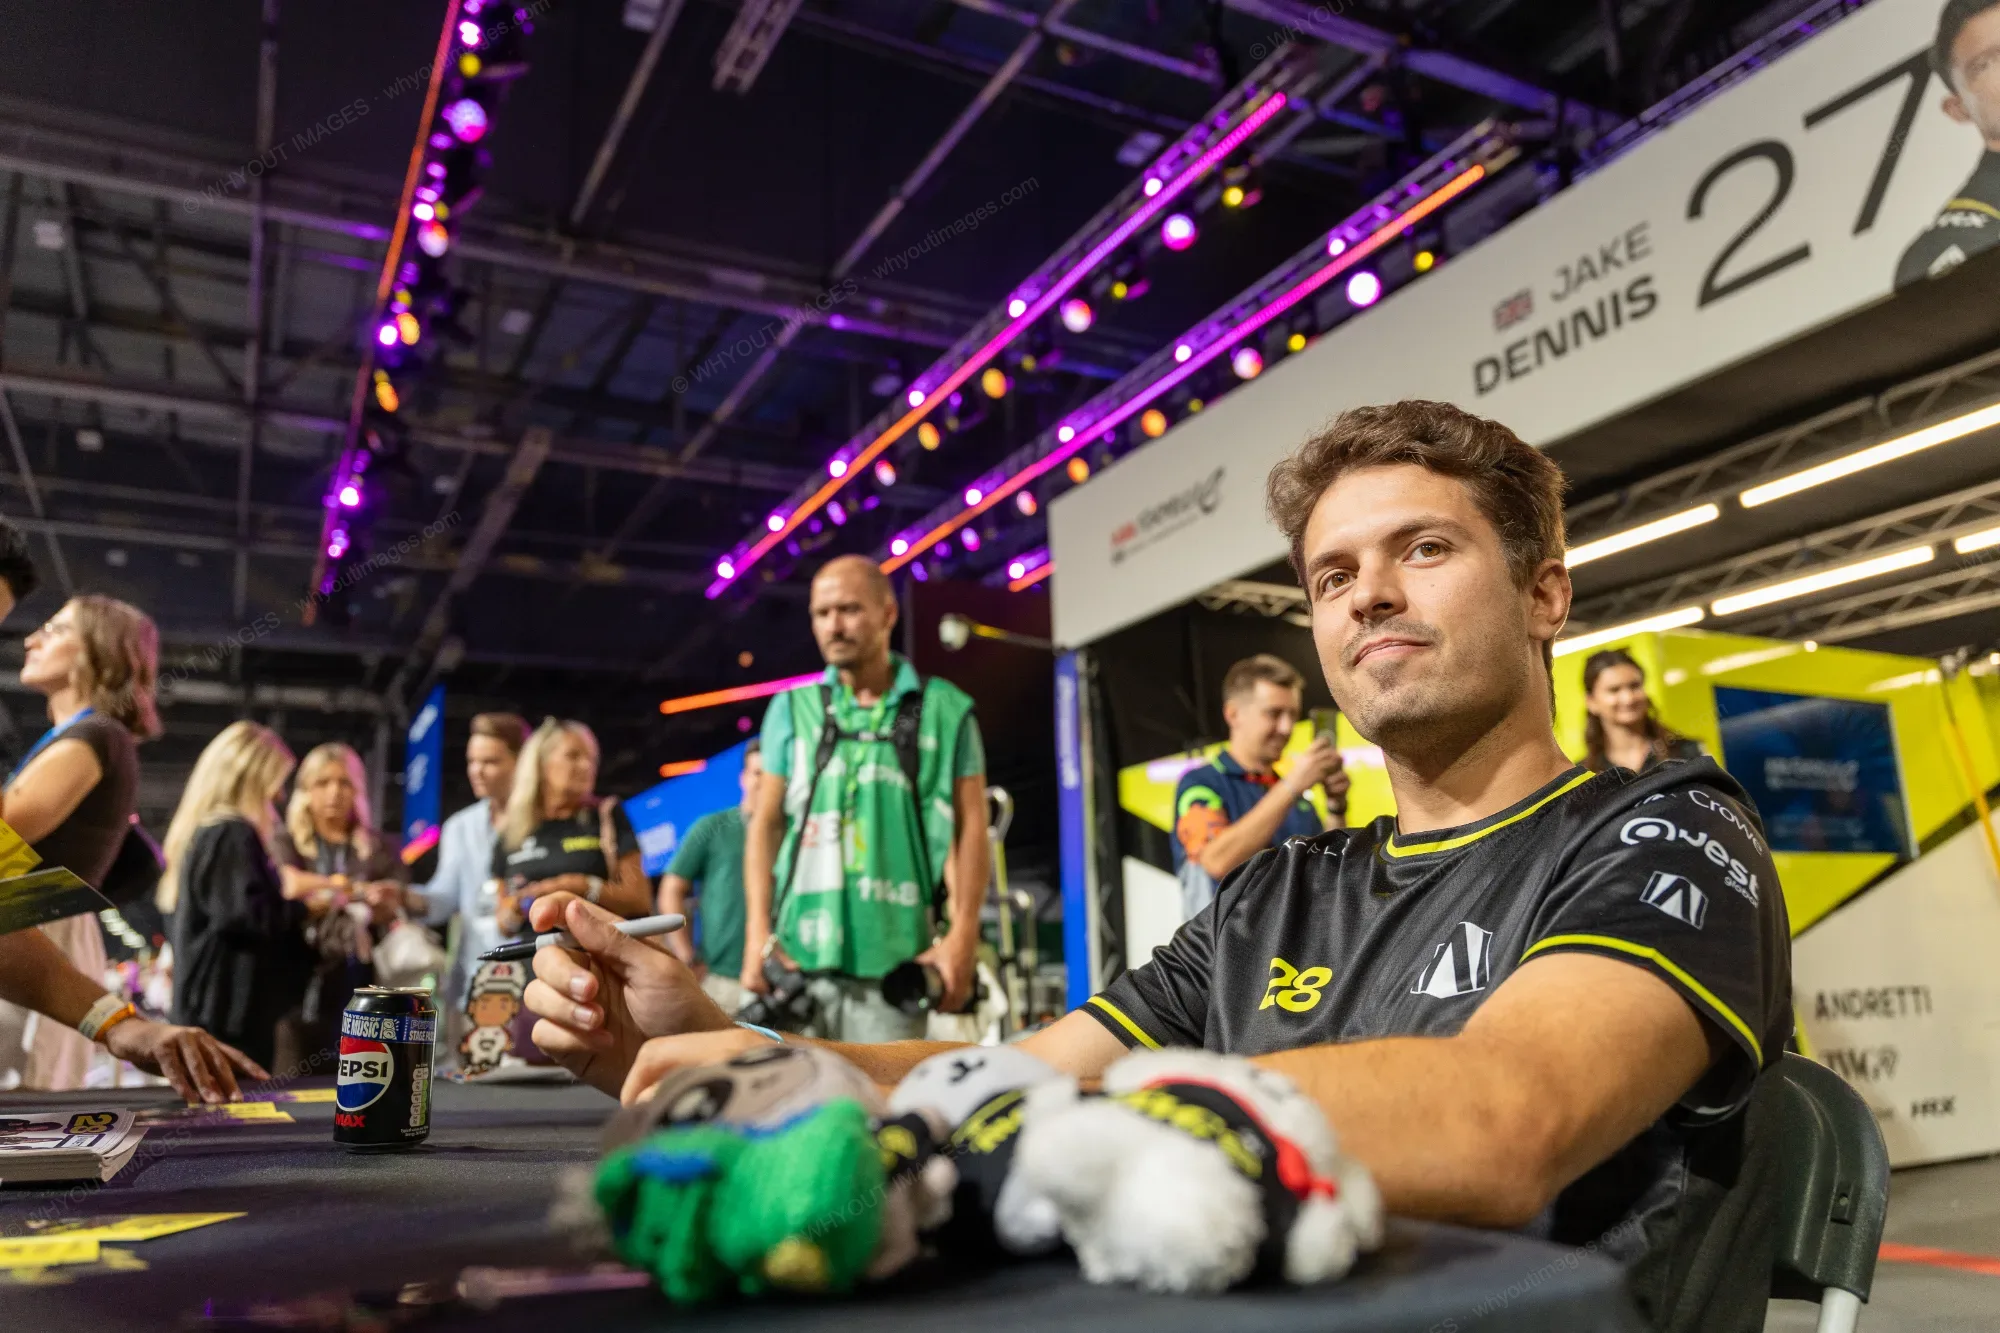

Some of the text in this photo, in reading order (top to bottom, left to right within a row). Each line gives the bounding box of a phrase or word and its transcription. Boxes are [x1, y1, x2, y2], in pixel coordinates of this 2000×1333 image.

[1684, 45, 1934, 308] 27
[1550, 220, 1654, 302] JAKE
[1473, 275, 1658, 396] DENNIS
[1688, 790, 1763, 856] Crowe
[1620, 817, 1760, 900] Quest
[1258, 957, 1333, 1012] 28
[351, 1019, 380, 1039] MUSIC
[339, 1060, 388, 1078] EPSI
[335, 1113, 366, 1128] MAX
